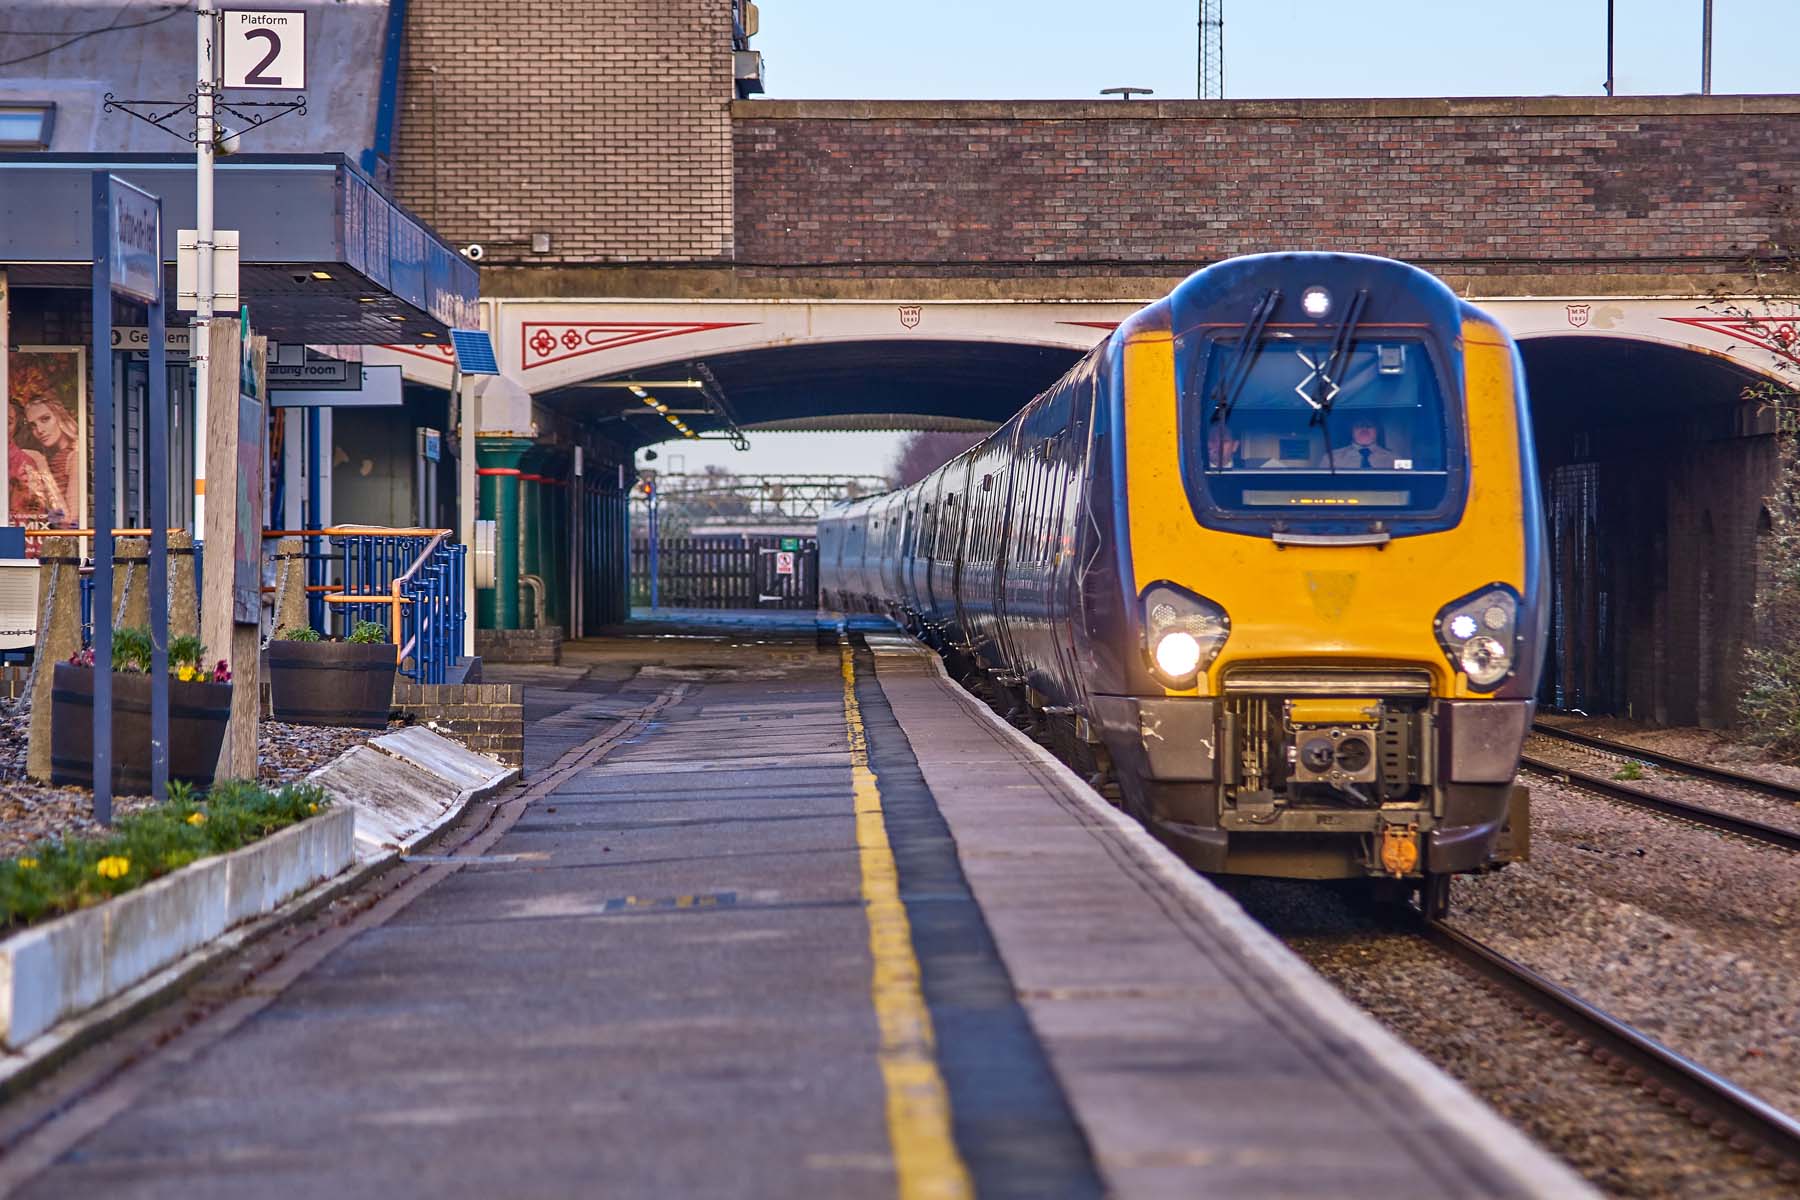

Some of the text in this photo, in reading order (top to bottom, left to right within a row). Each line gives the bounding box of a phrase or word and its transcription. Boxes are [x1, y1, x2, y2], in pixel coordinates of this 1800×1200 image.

[241, 14, 288, 25] Platform
[244, 28, 282, 85] 2
[304, 366, 336, 375] room
